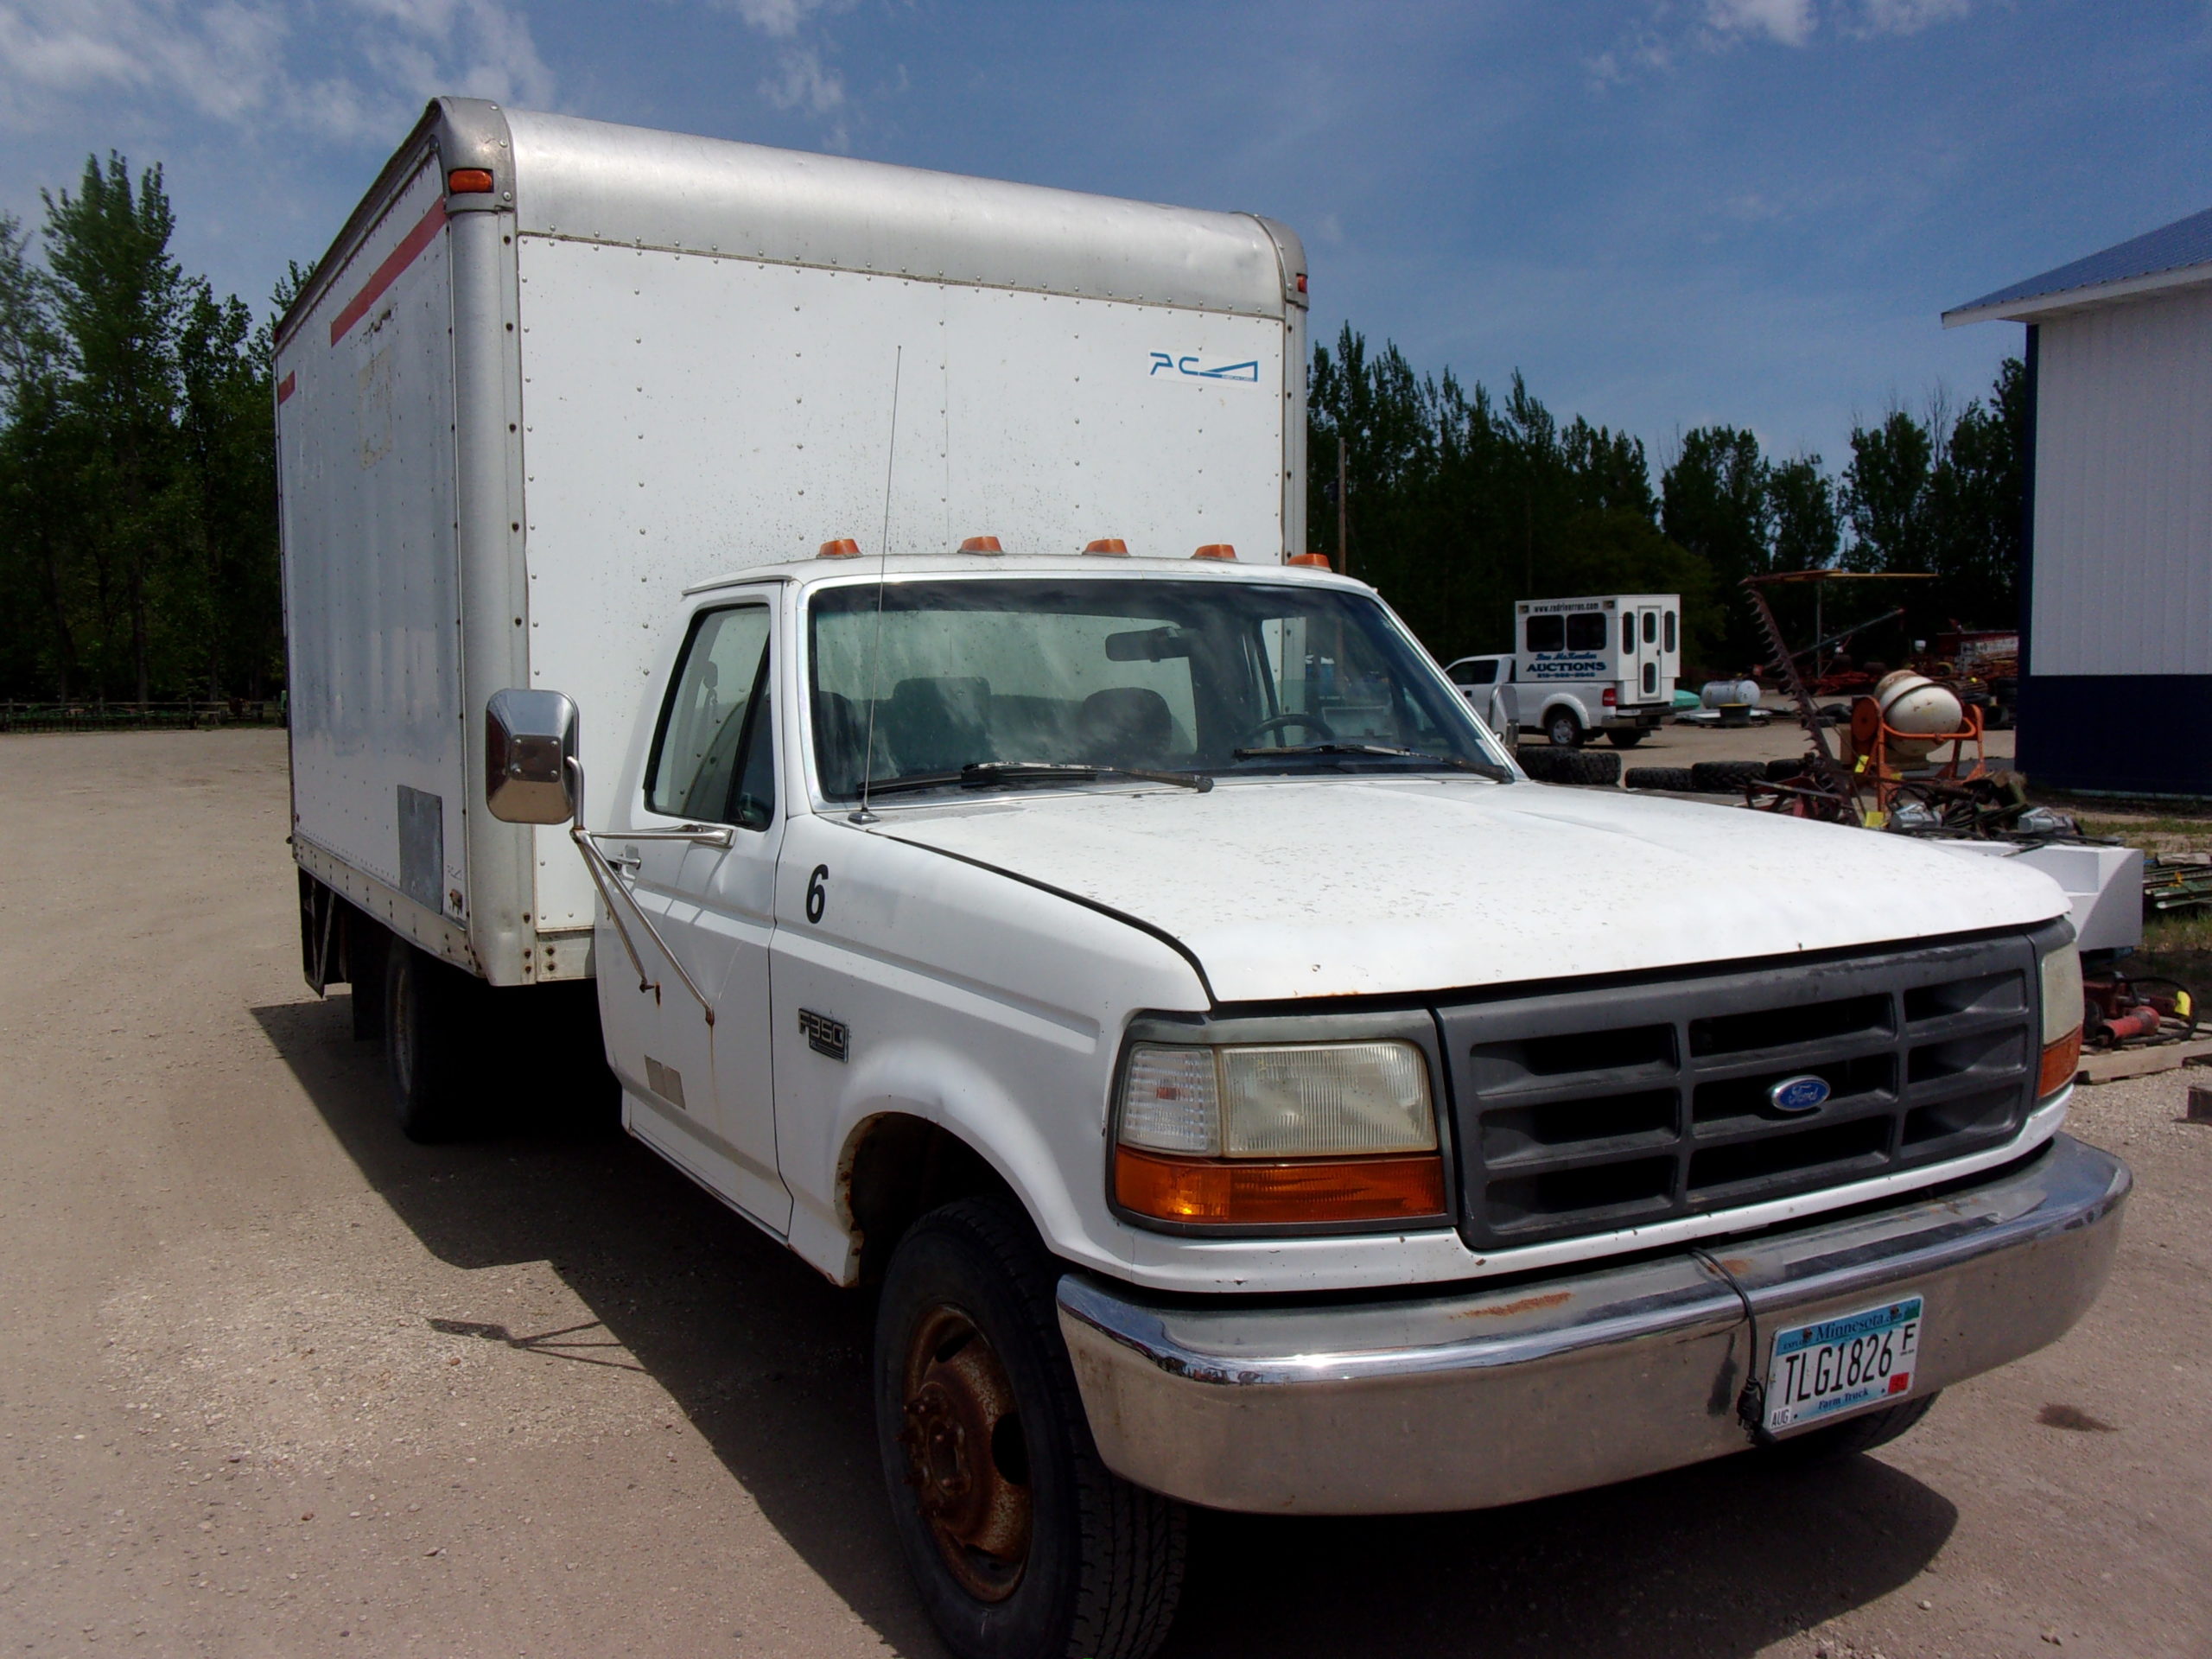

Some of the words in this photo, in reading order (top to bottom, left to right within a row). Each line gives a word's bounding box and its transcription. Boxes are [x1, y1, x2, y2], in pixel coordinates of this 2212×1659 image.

[1527, 662, 1606, 671] AUCTIONS
[806, 864, 829, 924] 6
[1815, 1314, 1885, 1340] Minnesota
[1903, 1323, 1916, 1350] F
[1785, 1330, 1893, 1405] TLG1826
[1818, 1397, 1841, 1410] Farm
[1844, 1387, 1869, 1402] Truck
[1771, 1409, 1789, 1427] AUG
